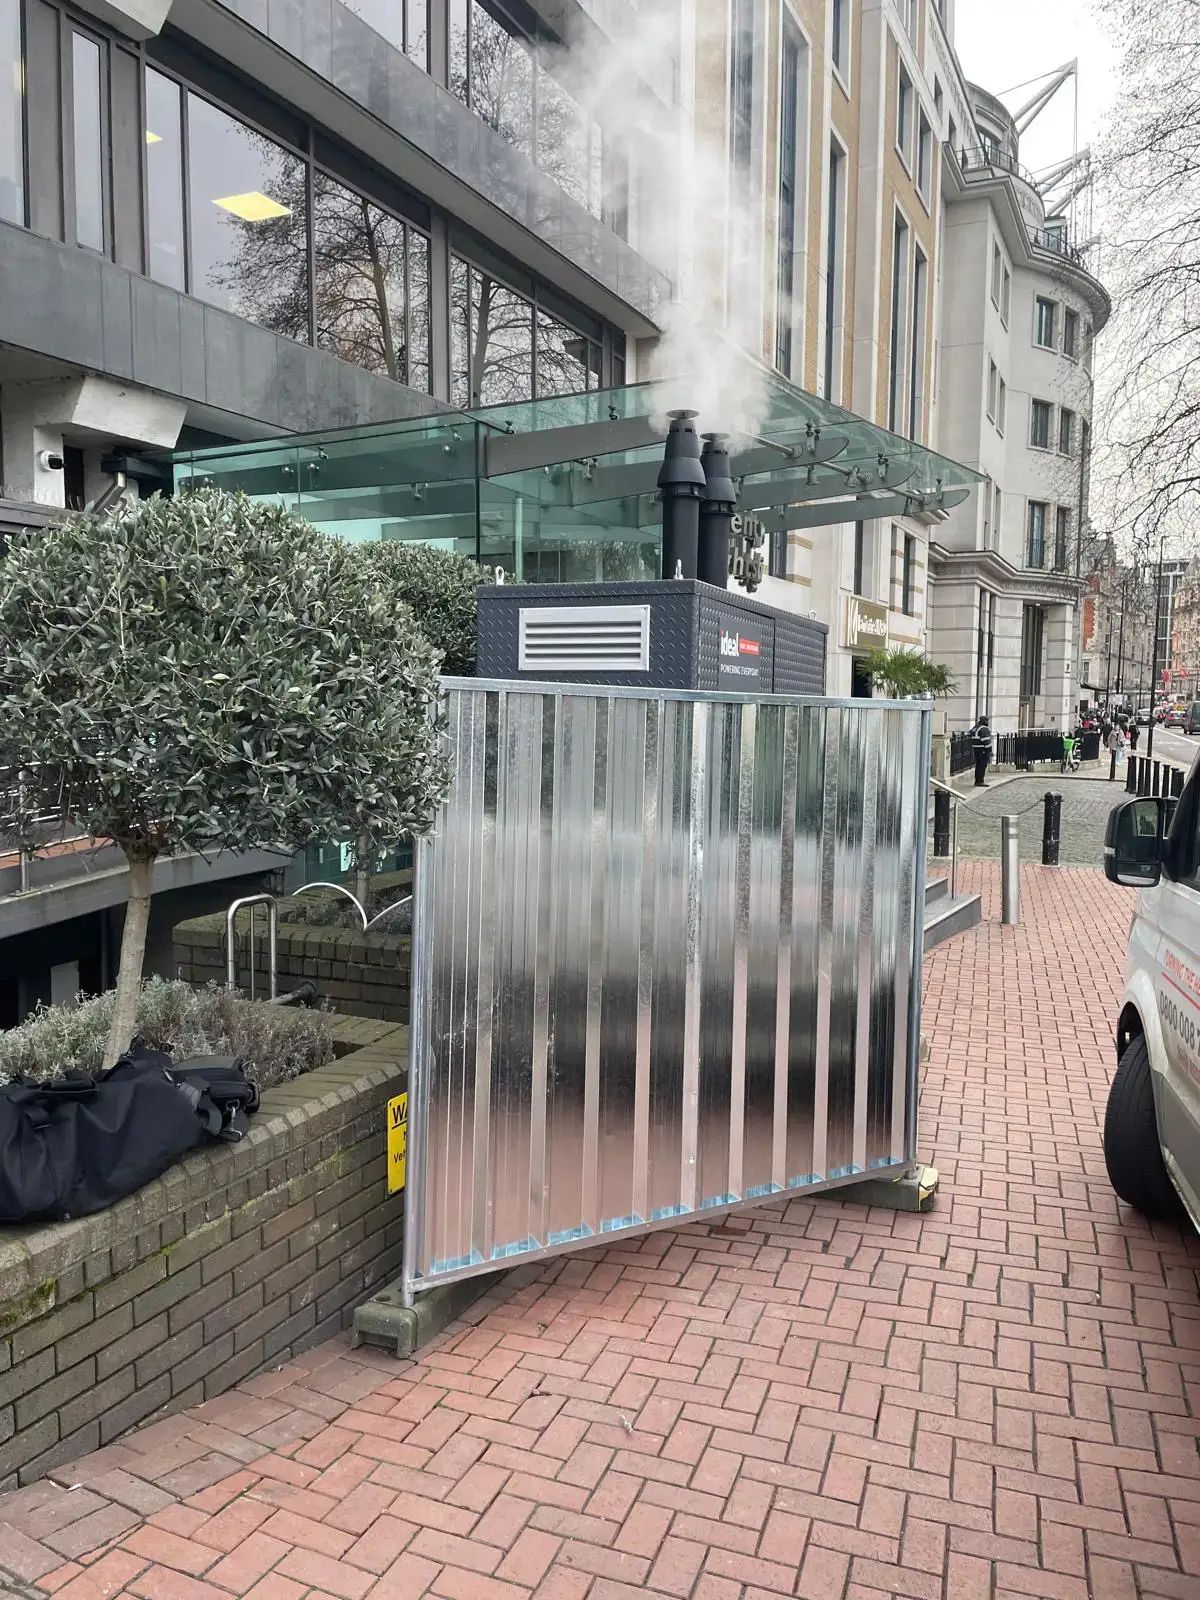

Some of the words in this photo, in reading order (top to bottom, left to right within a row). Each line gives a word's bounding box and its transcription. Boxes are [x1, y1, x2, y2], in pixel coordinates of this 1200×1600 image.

[720, 629, 740, 657] ideal
[720, 663, 741, 676] POWERING
[1159, 990, 1178, 1031] 0800
[1179, 1010, 1195, 1050] 008
